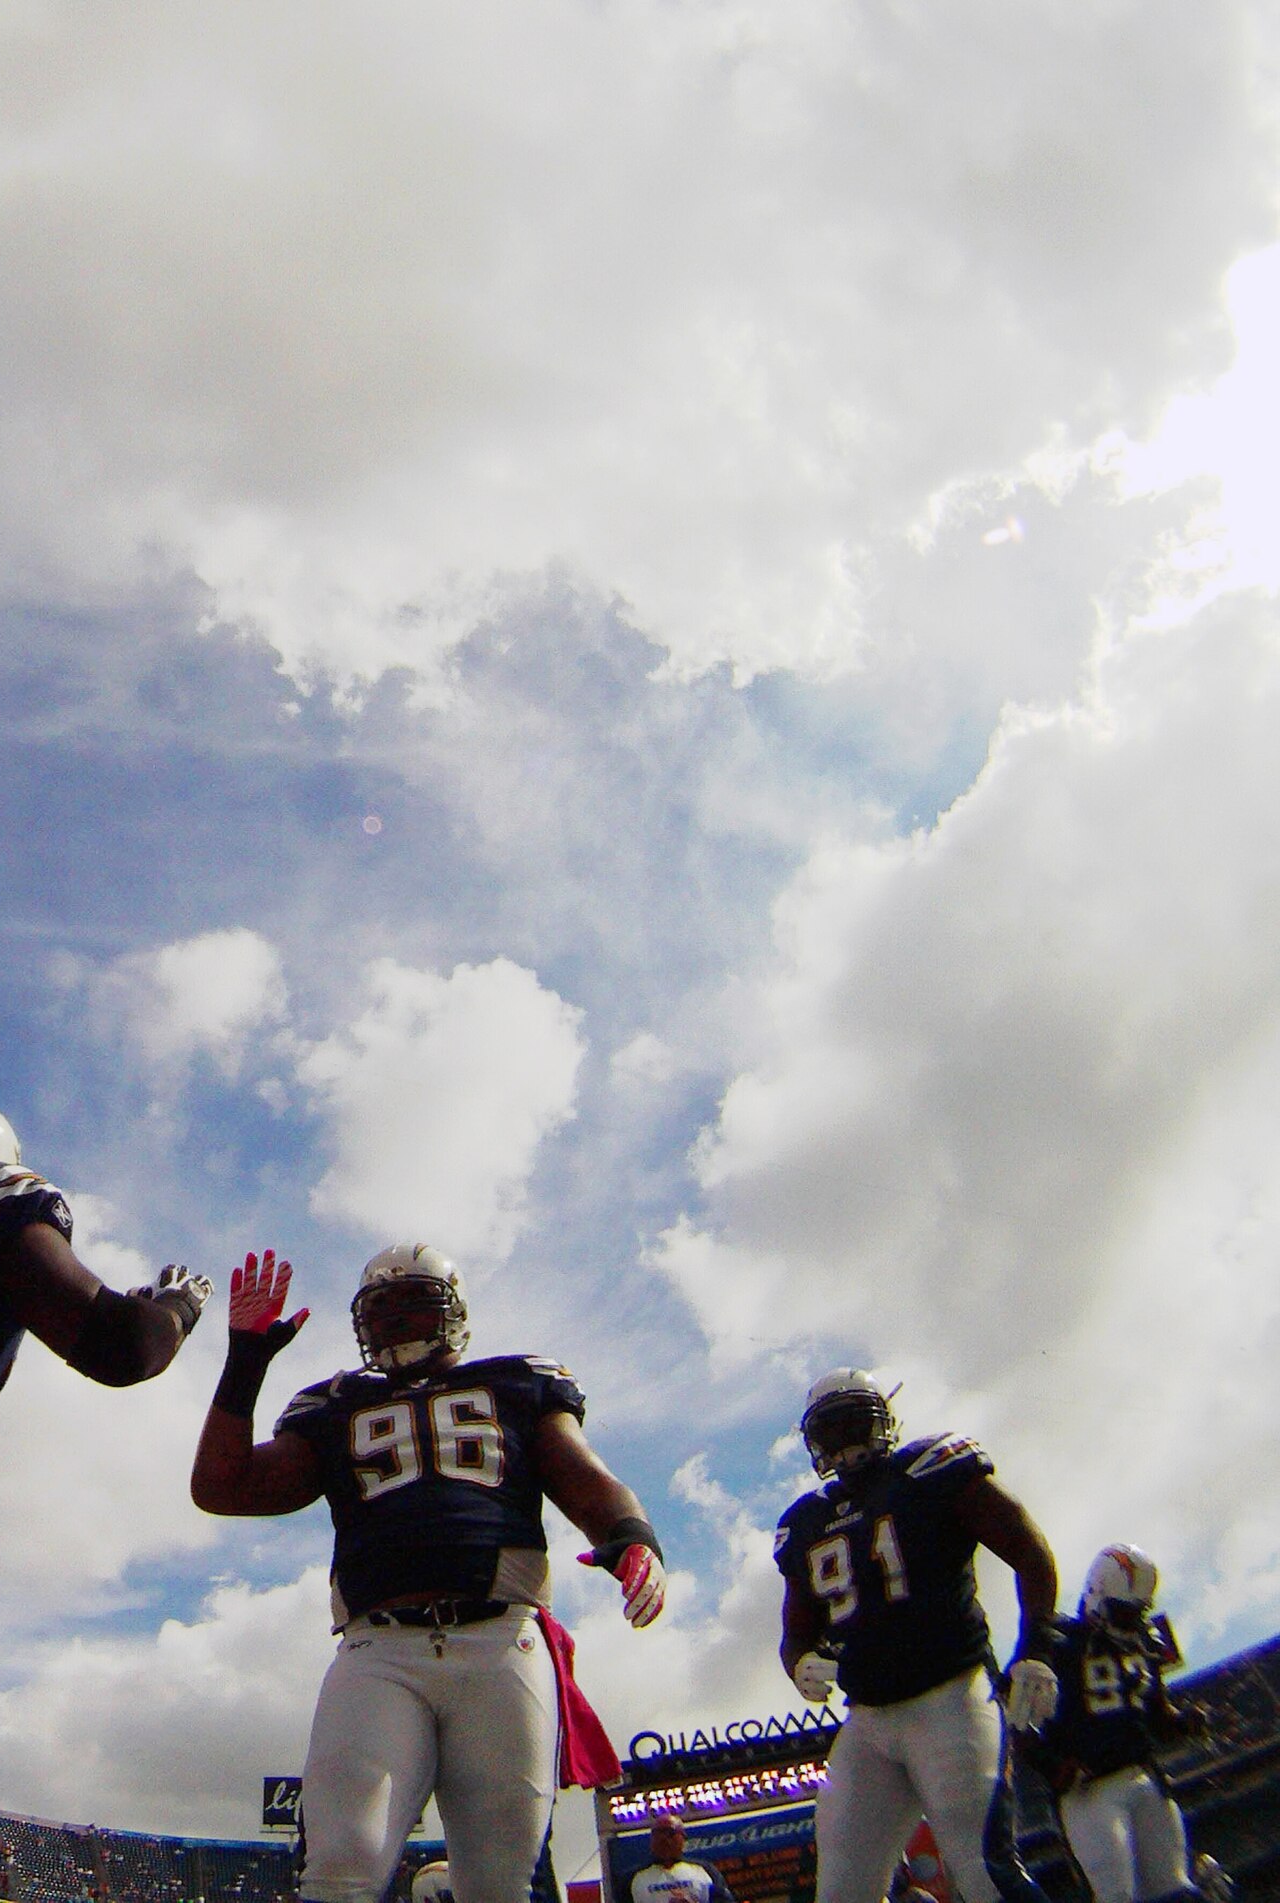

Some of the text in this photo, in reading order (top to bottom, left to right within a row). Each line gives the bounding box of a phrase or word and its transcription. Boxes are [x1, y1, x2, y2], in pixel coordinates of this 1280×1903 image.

[348, 1386, 506, 1501] 96
[807, 1514, 910, 1626] 91
[629, 1705, 842, 1768] QUALCOMM
